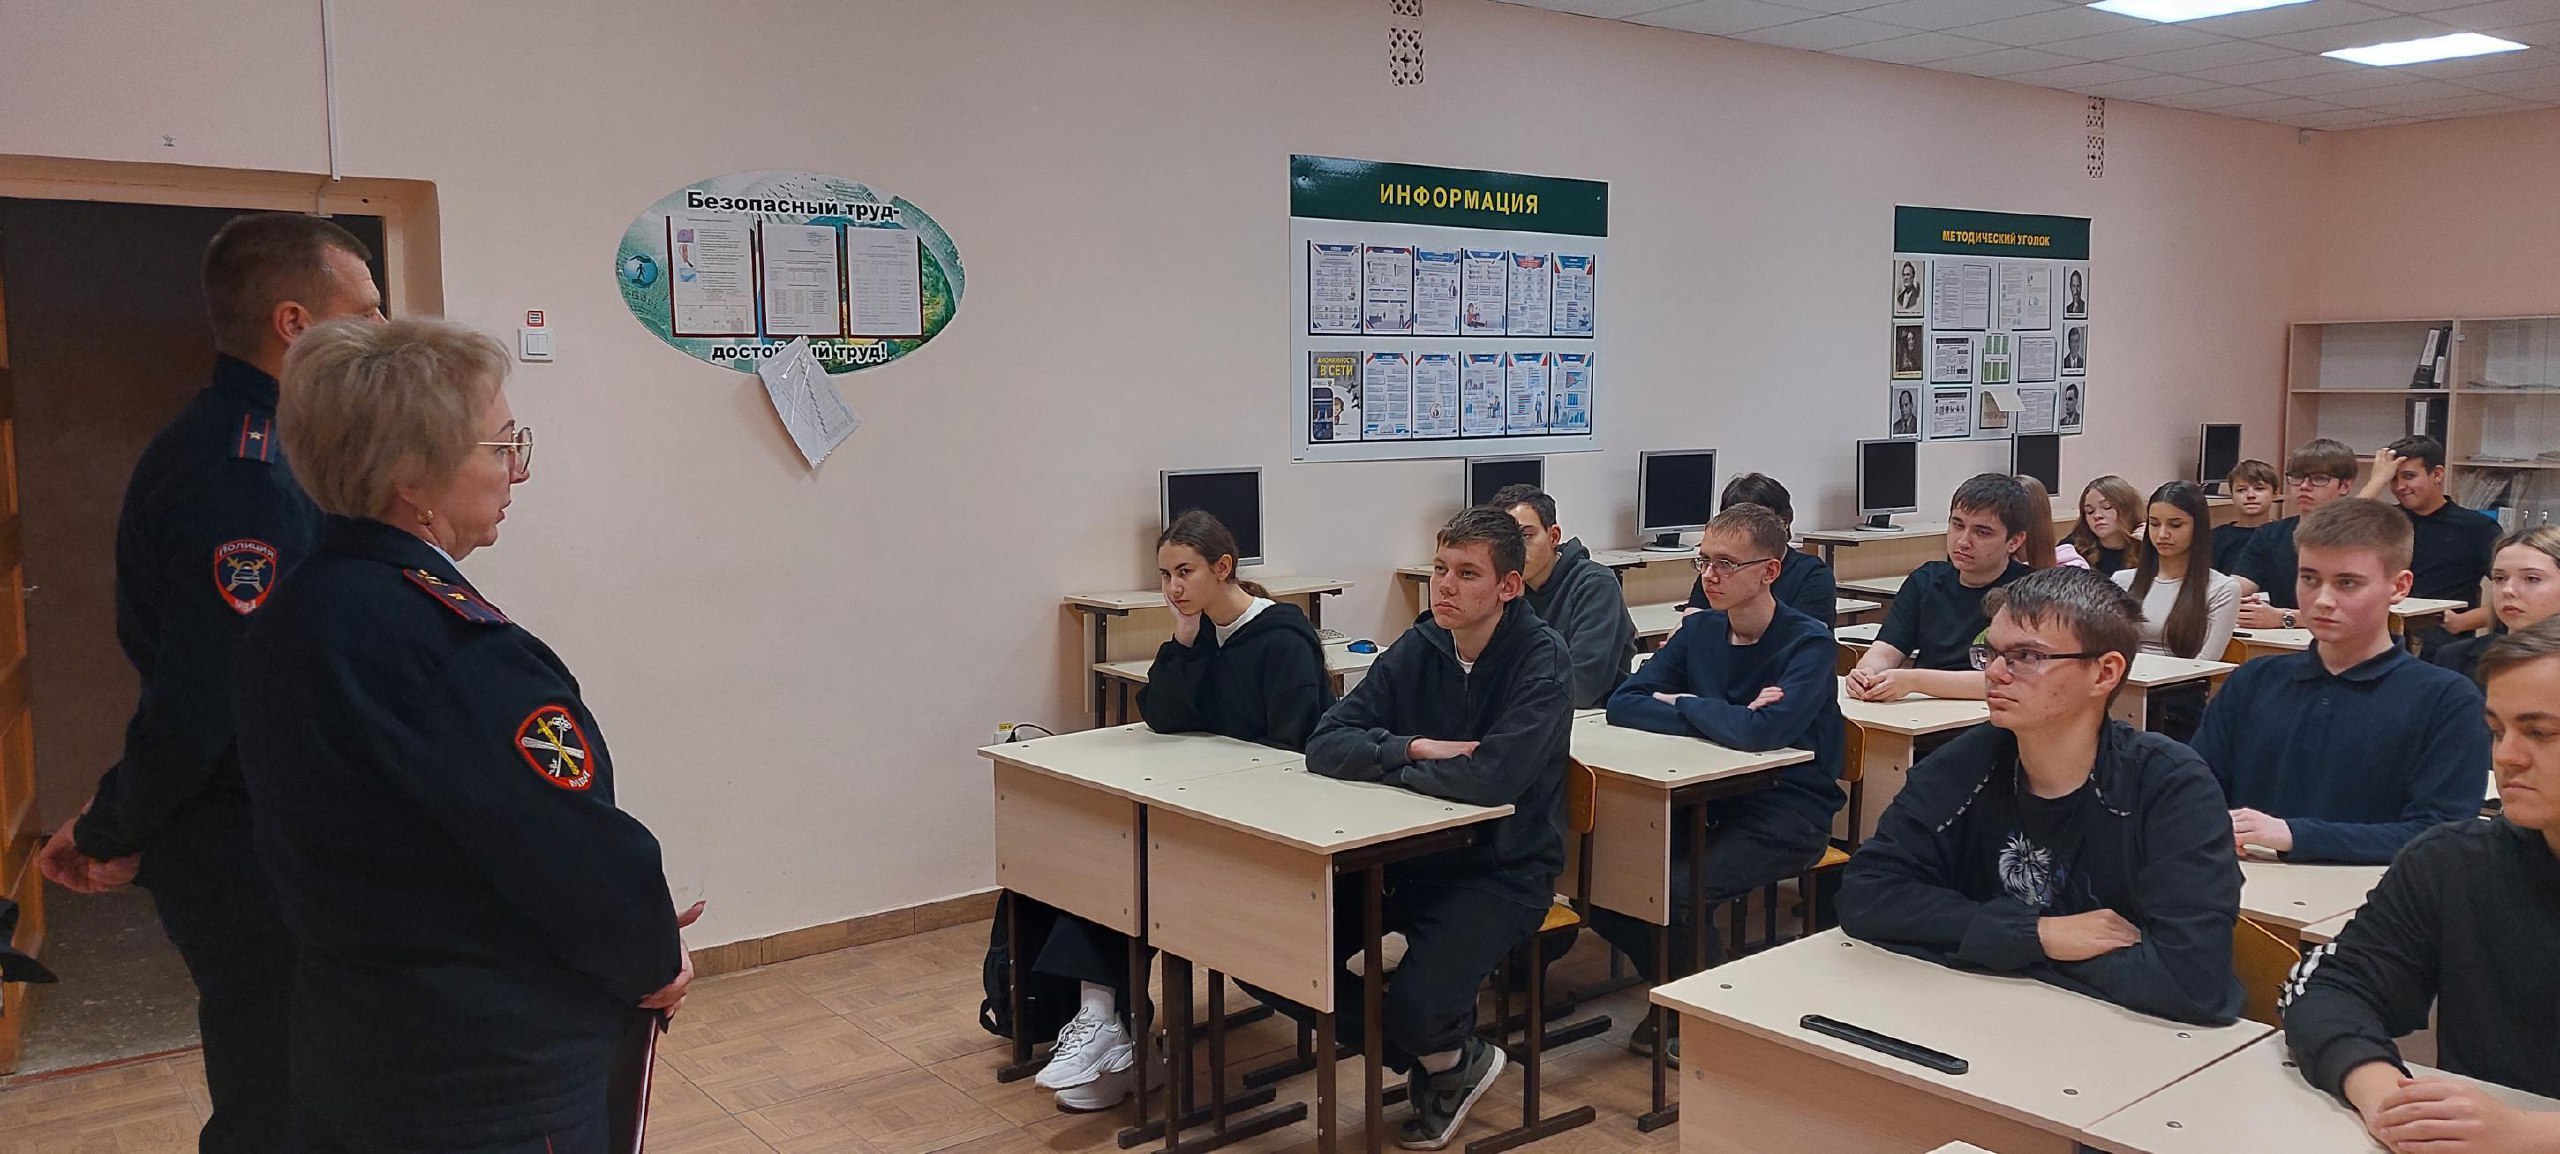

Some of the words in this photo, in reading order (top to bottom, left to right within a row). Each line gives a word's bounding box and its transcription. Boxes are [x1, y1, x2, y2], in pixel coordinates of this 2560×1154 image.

[687, 191, 838, 216] Безопасный
[1380, 183, 1538, 216] ИНФОРМАЦИЯ
[1942, 230, 2016, 245] МЕТОДИЧЕСКИЙ
[2017, 234, 2050, 246] УГОЛОК
[838, 343, 887, 363] труд!
[1320, 364, 1327, 376] В
[1328, 364, 1353, 376] СЕТИ
[219, 542, 274, 559] ПОЛИЦИЯ
